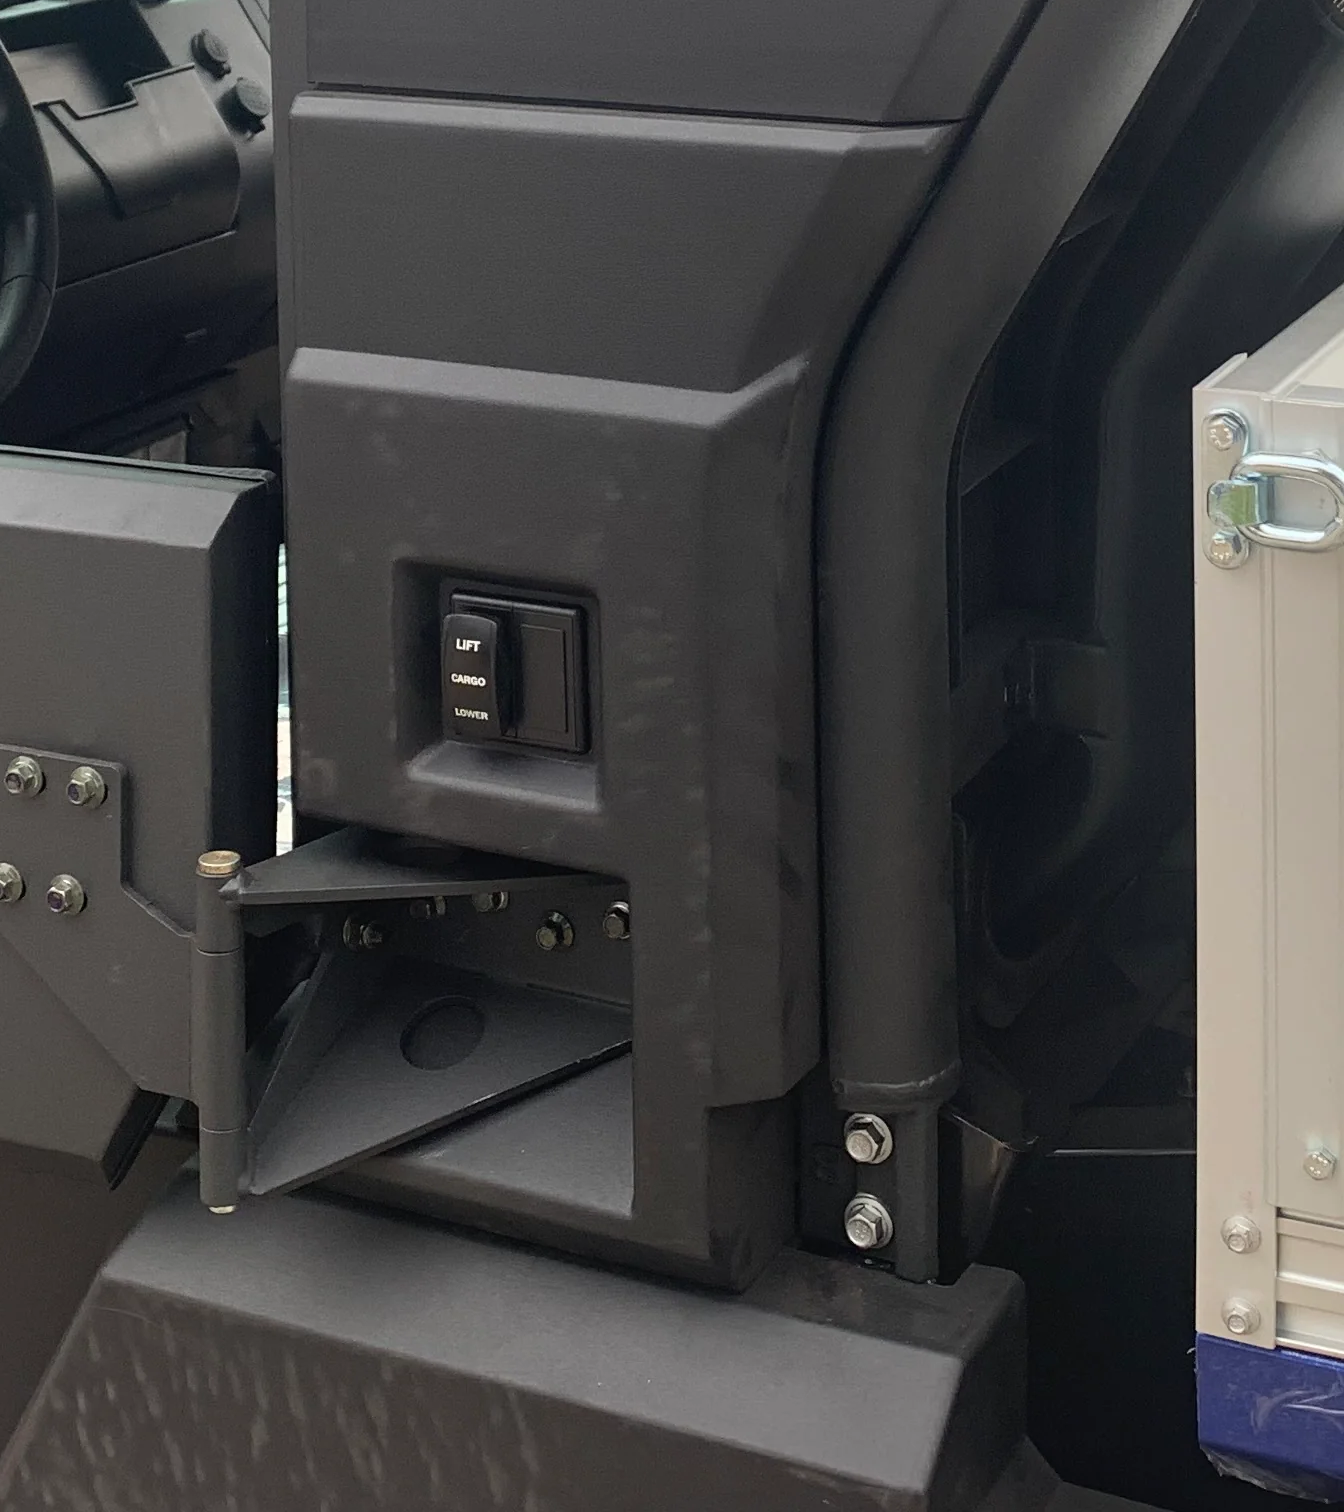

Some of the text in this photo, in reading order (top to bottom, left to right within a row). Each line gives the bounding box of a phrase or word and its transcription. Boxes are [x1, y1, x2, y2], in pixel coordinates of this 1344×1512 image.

[455, 638, 482, 652] LIFT
[451, 673, 486, 687] CARGO
[455, 707, 489, 721] LOWER
